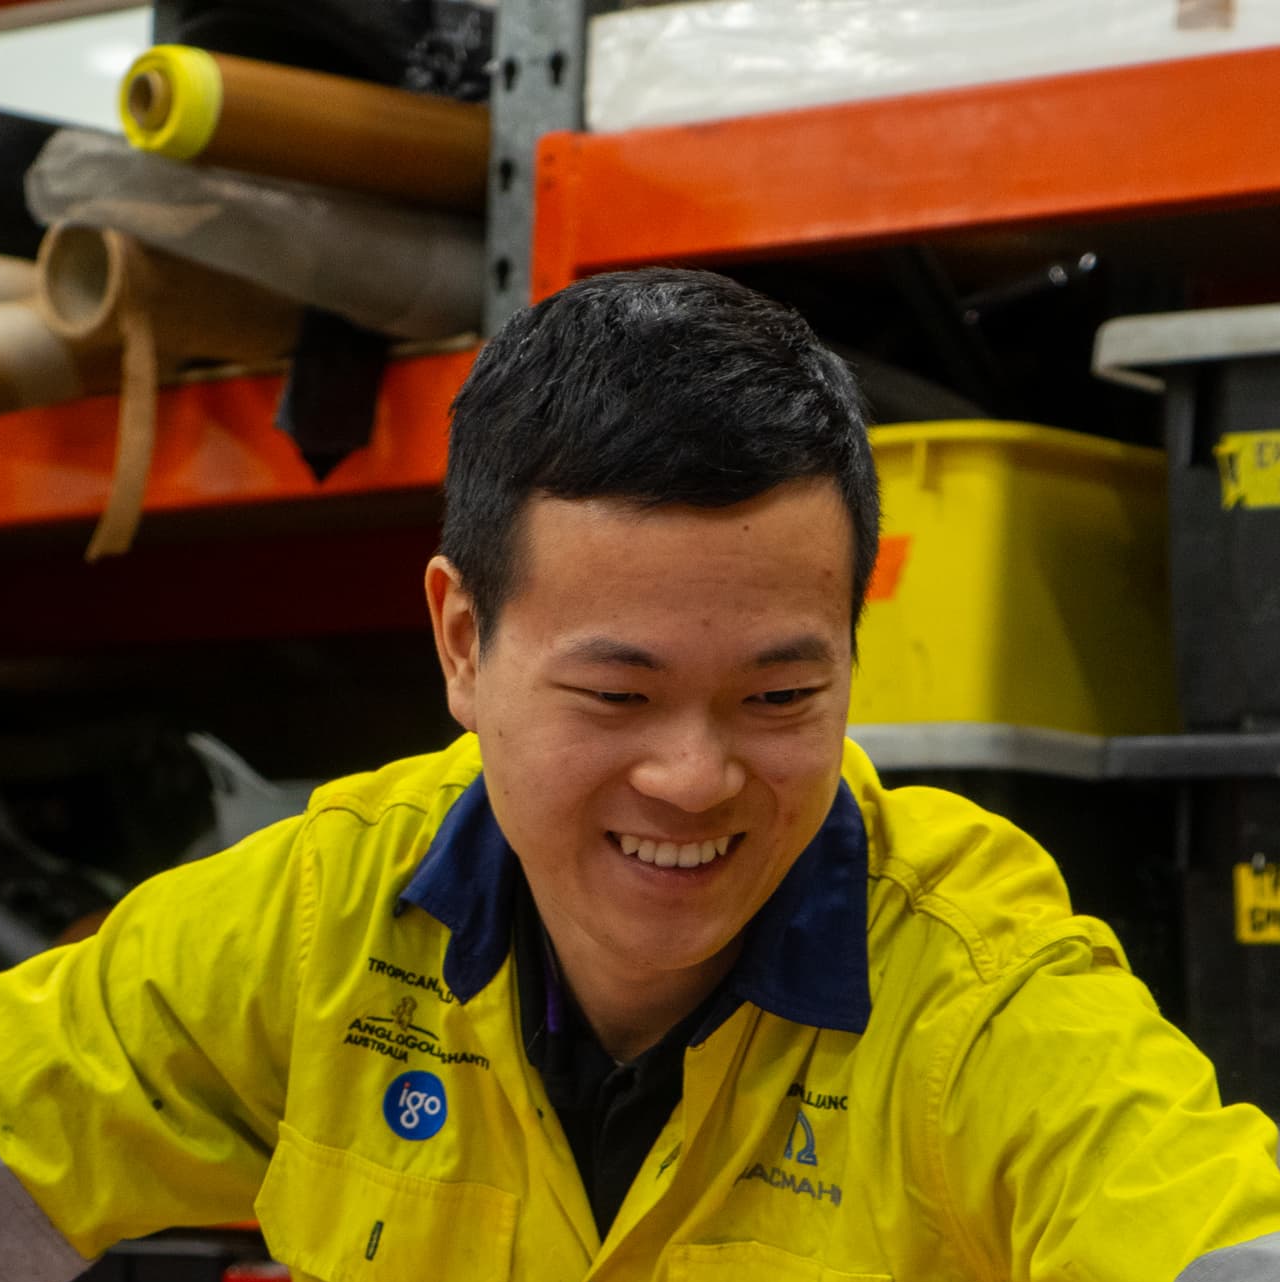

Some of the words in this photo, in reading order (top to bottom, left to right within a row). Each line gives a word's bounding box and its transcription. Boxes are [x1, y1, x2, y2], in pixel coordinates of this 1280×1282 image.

[367, 957, 443, 993] TROPICAN
[344, 1033, 409, 1063] AUSTRALIA
[399, 1081, 441, 1129] igo
